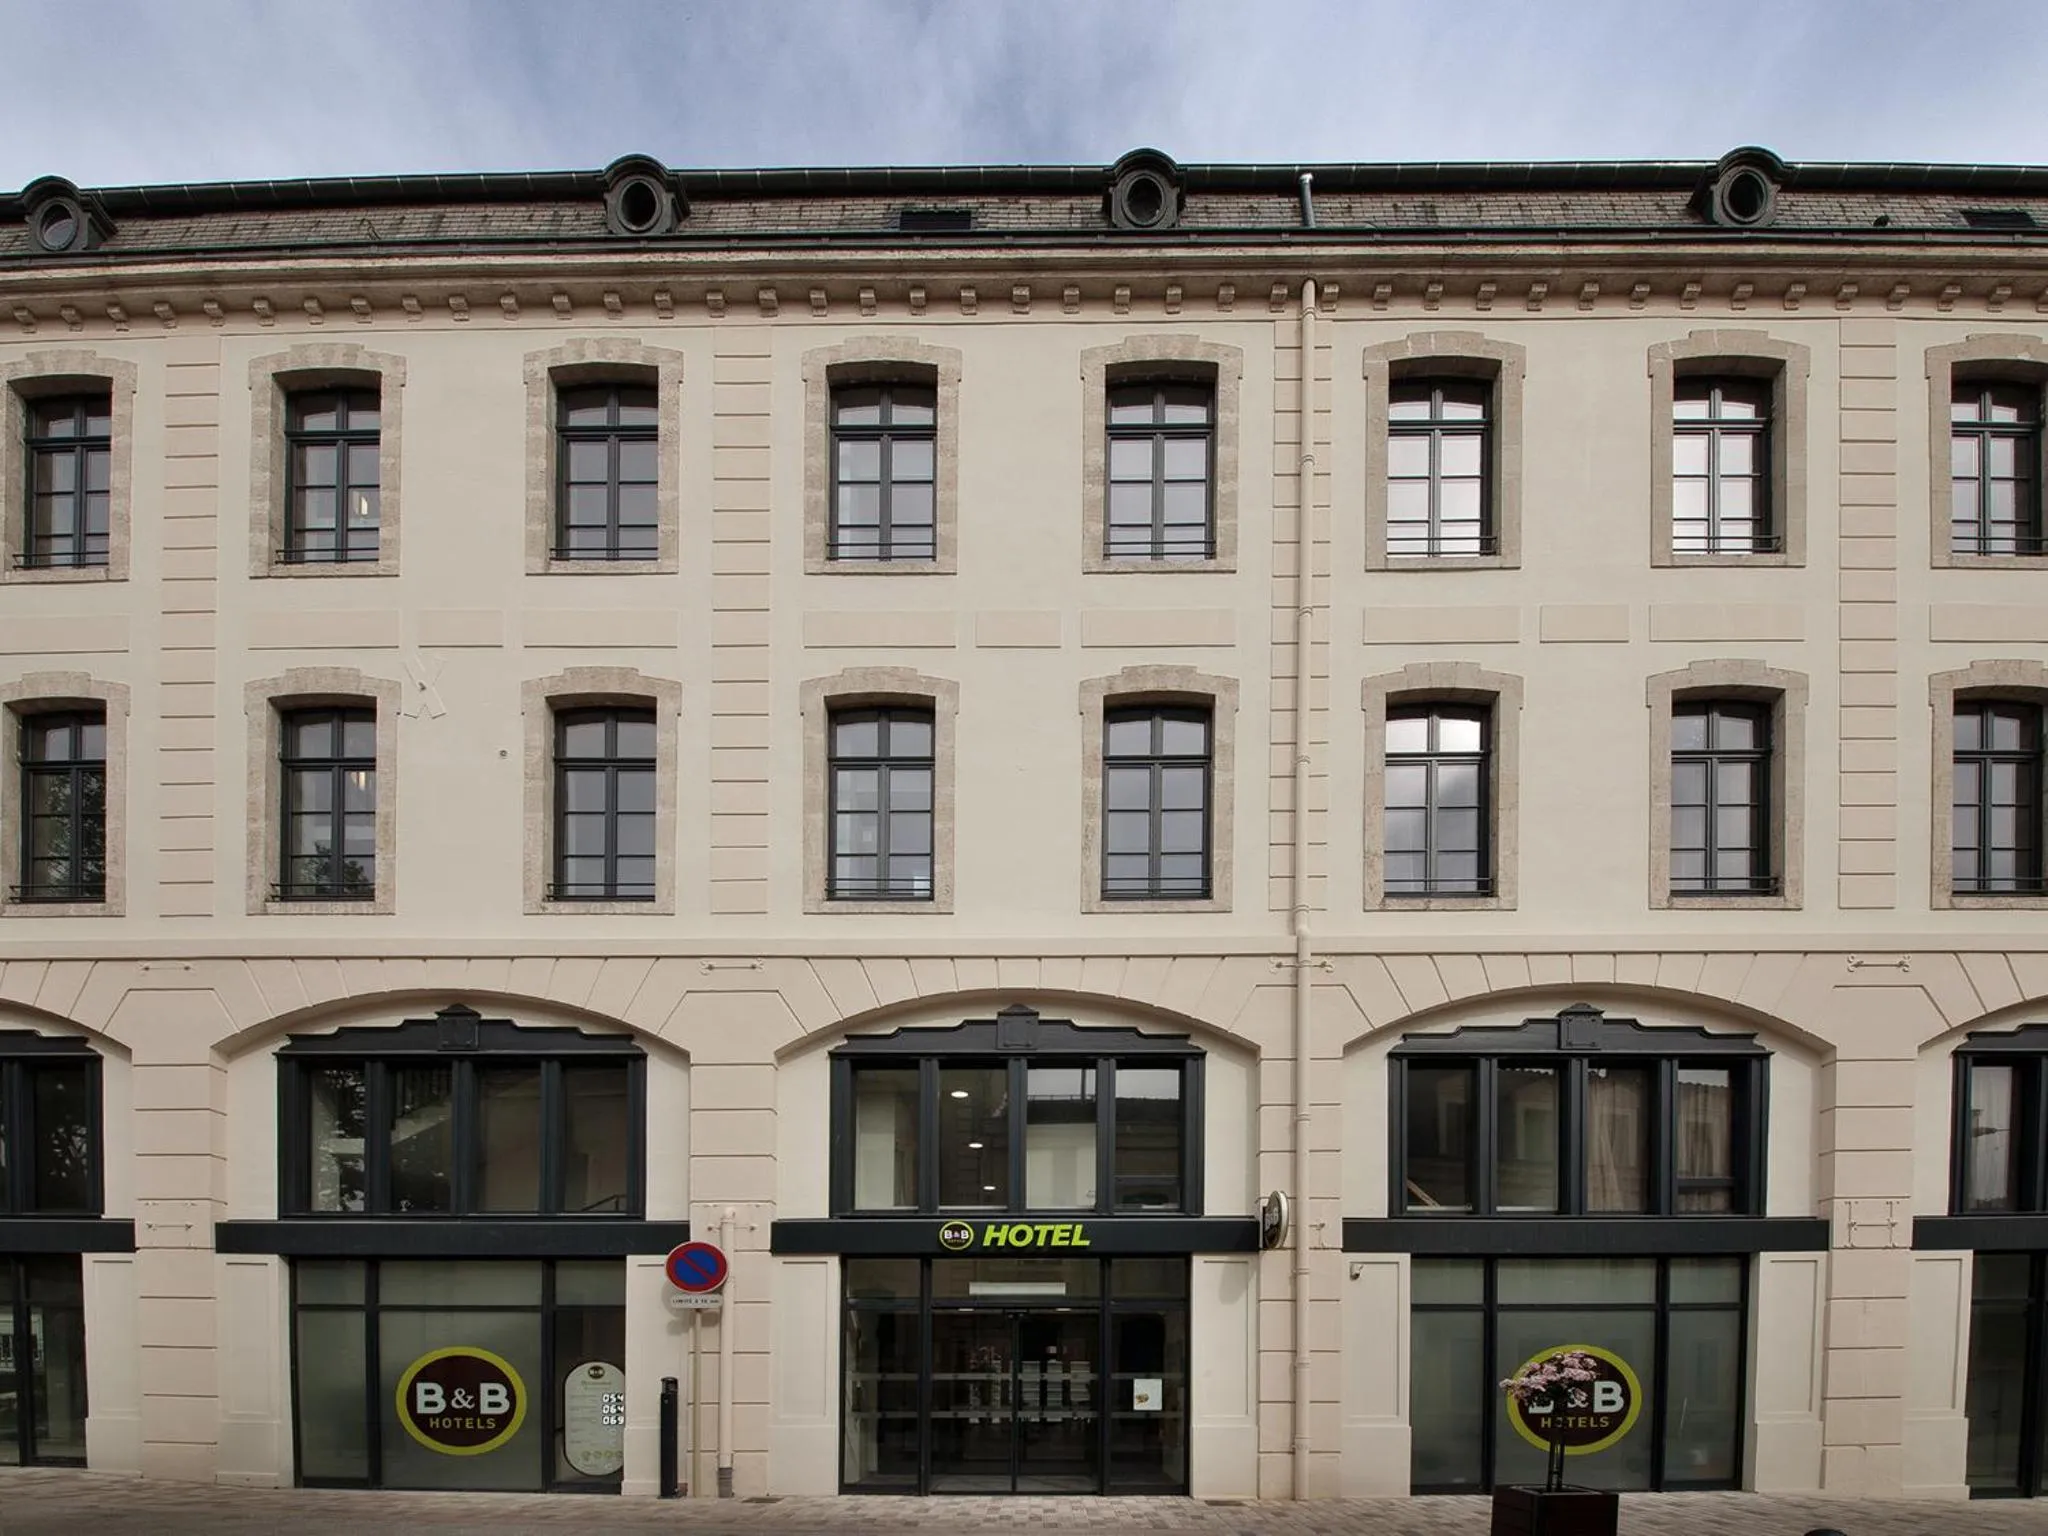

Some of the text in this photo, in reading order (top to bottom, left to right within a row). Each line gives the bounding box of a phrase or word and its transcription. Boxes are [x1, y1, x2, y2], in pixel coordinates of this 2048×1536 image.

[982, 1224, 1091, 1247] HOTEL
[416, 1382, 510, 1414] B&B
[429, 1417, 497, 1429] HOTELS
[602, 1415, 624, 1425] 069
